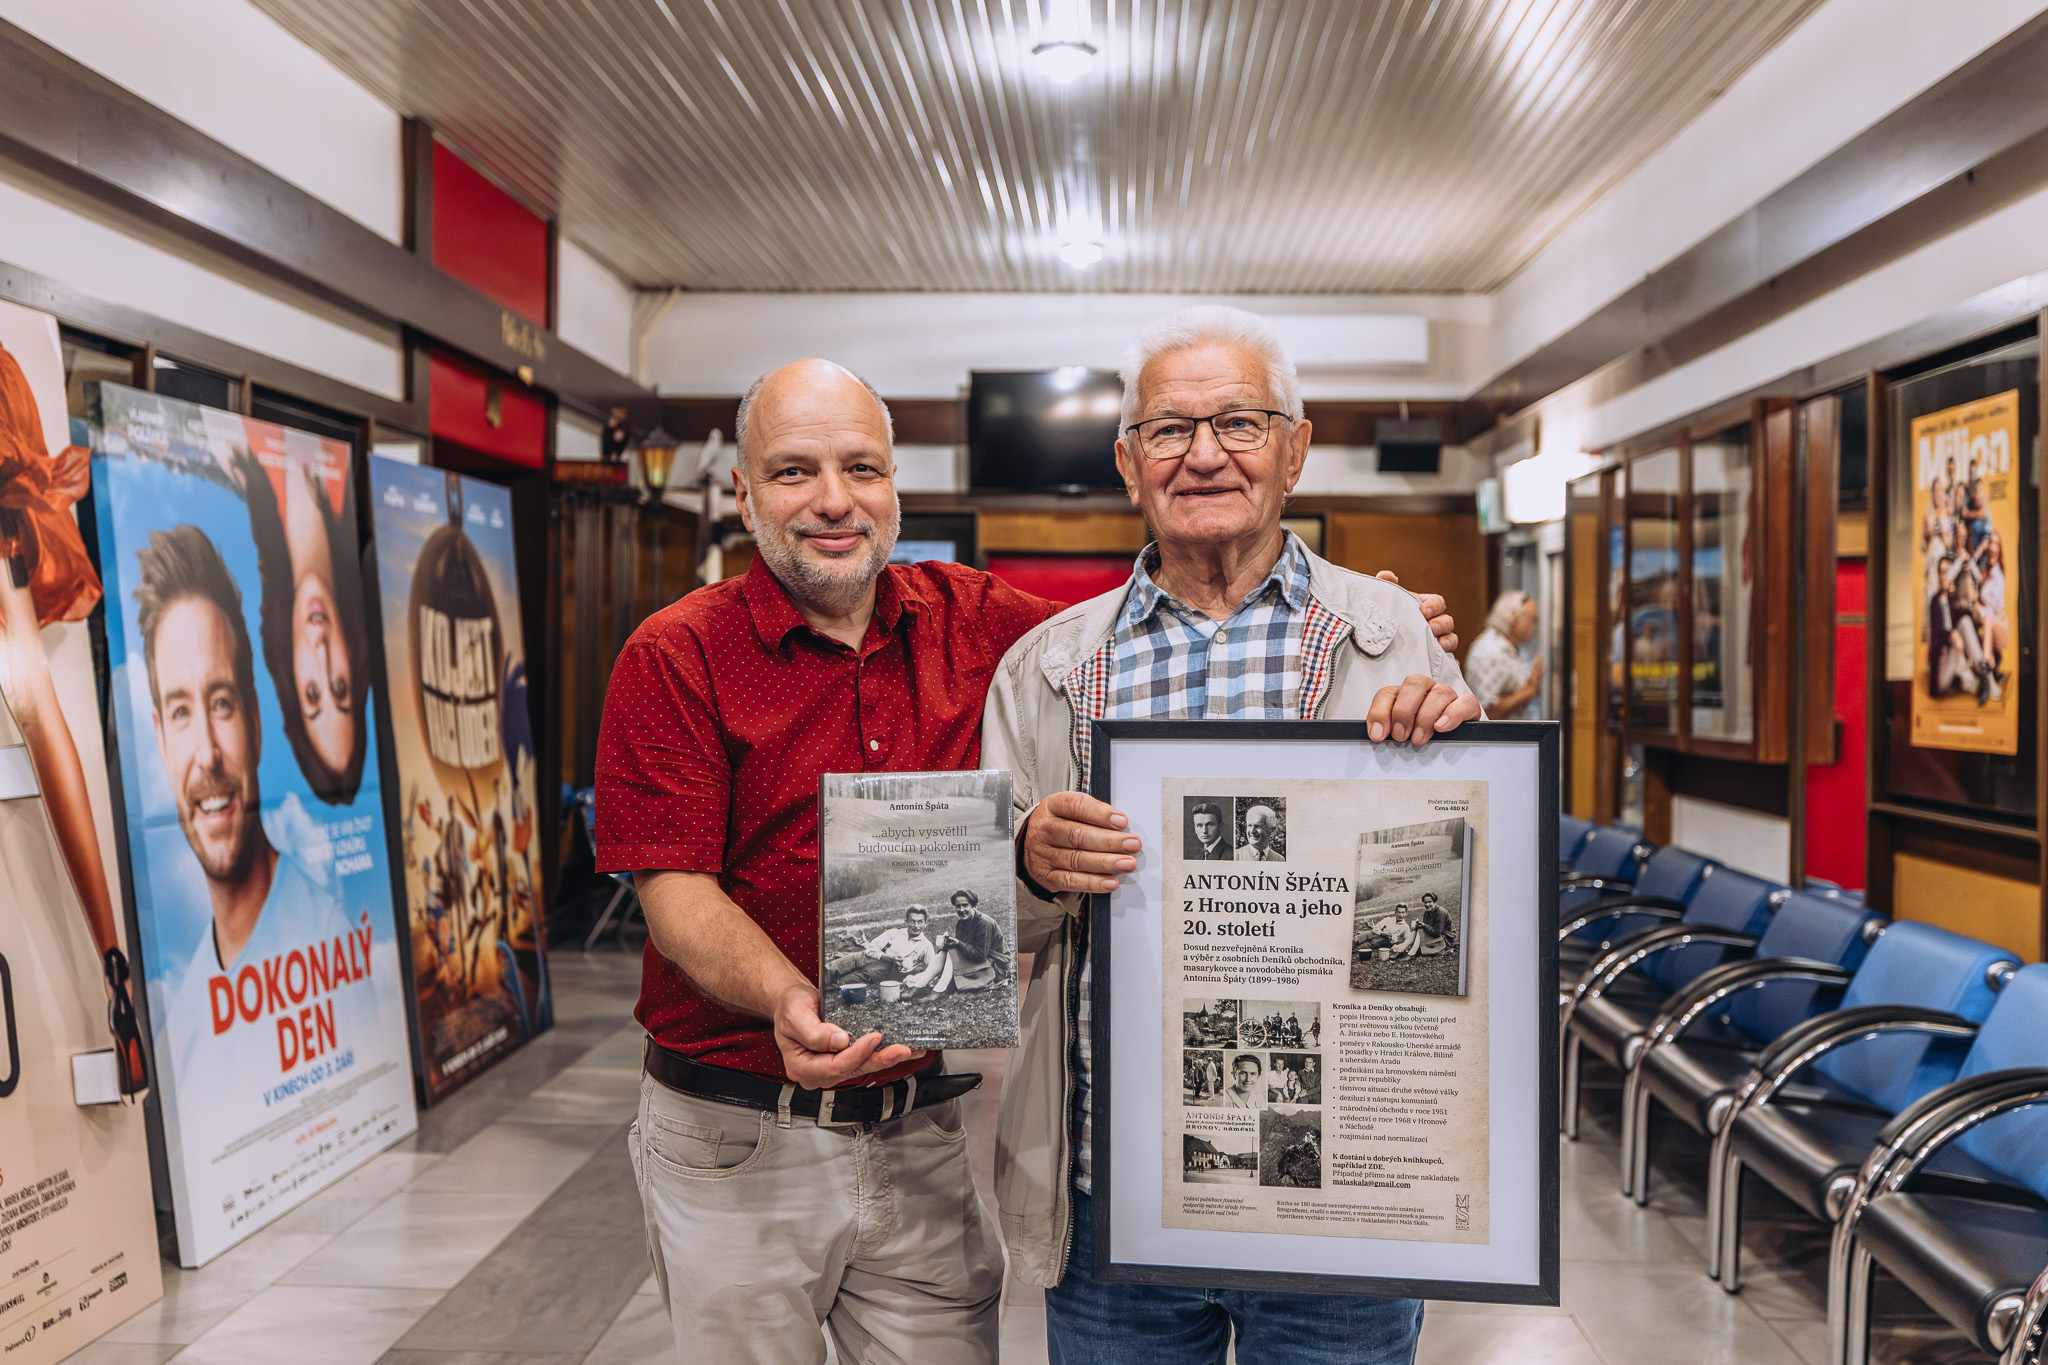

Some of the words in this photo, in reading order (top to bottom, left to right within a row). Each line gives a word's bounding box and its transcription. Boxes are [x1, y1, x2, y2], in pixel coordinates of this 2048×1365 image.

[1919, 427, 2010, 490] Milion
[889, 802, 923, 810] Antonín
[925, 800, 949, 811] Špáta
[872, 826, 915, 840] ...abych
[919, 825, 967, 839] vysvětlil
[858, 841, 916, 853] budoucím
[920, 840, 980, 855] pokolením
[1411, 839, 1424, 848] Špáta
[1380, 857, 1405, 866] ...abych
[1406, 853, 1434, 862] vysvětlil
[1374, 864, 1404, 874] budoucím
[1405, 861, 1442, 873] pokolením
[1183, 871, 1280, 891] ANTONÍN
[1286, 873, 1350, 892] ŠPÁTA
[1184, 901, 1193, 913] z
[1199, 897, 1280, 914] Hronova
[1286, 903, 1296, 914] a
[1300, 899, 1342, 919] jeho
[1184, 920, 1211, 936] 20.
[1217, 921, 1275, 937] století
[1184, 943, 1209, 952] Dosud
[1212, 944, 1267, 955] nezveřejněná
[1270, 945, 1303, 953] Kronika
[1190, 954, 1214, 964] výběr
[1222, 954, 1259, 963] osobních
[1262, 955, 1292, 964] Deníků
[1294, 956, 1345, 966] obchodníka,
[208, 910, 372, 1036] DOKONALÝ
[1184, 964, 1237, 975] masarykovce
[1246, 966, 1296, 974] novodobého
[1297, 967, 1333, 978] písmáka
[1183, 974, 1221, 982] Antonína
[1223, 974, 1246, 986] Špáty
[1249, 976, 1299, 987] (1899–1986)
[1368, 1004, 1393, 1013] Deníky
[1395, 1005, 1426, 1014] obsahují:
[1340, 1013, 1358, 1022] popis
[1394, 1015, 1409, 1024] jeho
[1411, 1015, 1439, 1024] obyvatel
[1441, 1016, 1456, 1025] před
[1340, 1022, 1358, 1030] první
[276, 998, 337, 1073] DEN
[1400, 1032, 1445, 1041] Hostovského)
[1340, 1040, 1365, 1049] poměry
[1372, 1041, 1434, 1049] Rakousko-Uherské
[1345, 1048, 1373, 1057] posádky
[1340, 1066, 1374, 1076] podnikání
[1349, 1075, 1367, 1084] první
[1369, 1075, 1401, 1085] republiky
[263, 1090, 271, 1107] V
[274, 1073, 309, 1102] KINECH
[310, 1066, 324, 1085] OD
[1440, 1088, 1459, 1097] války
[1372, 1096, 1399, 1105] nástupu
[1340, 1133, 1372, 1142] rozjímání
[1373, 1155, 1402, 1164] dobrých
[1333, 1161, 1366, 1171] například
[1333, 1170, 1363, 1179] Případně
[1365, 1171, 1385, 1180] přímo
[1421, 1174, 1460, 1182] nakladatele
[1333, 1179, 1411, 1188] malaskala@gmail.com
